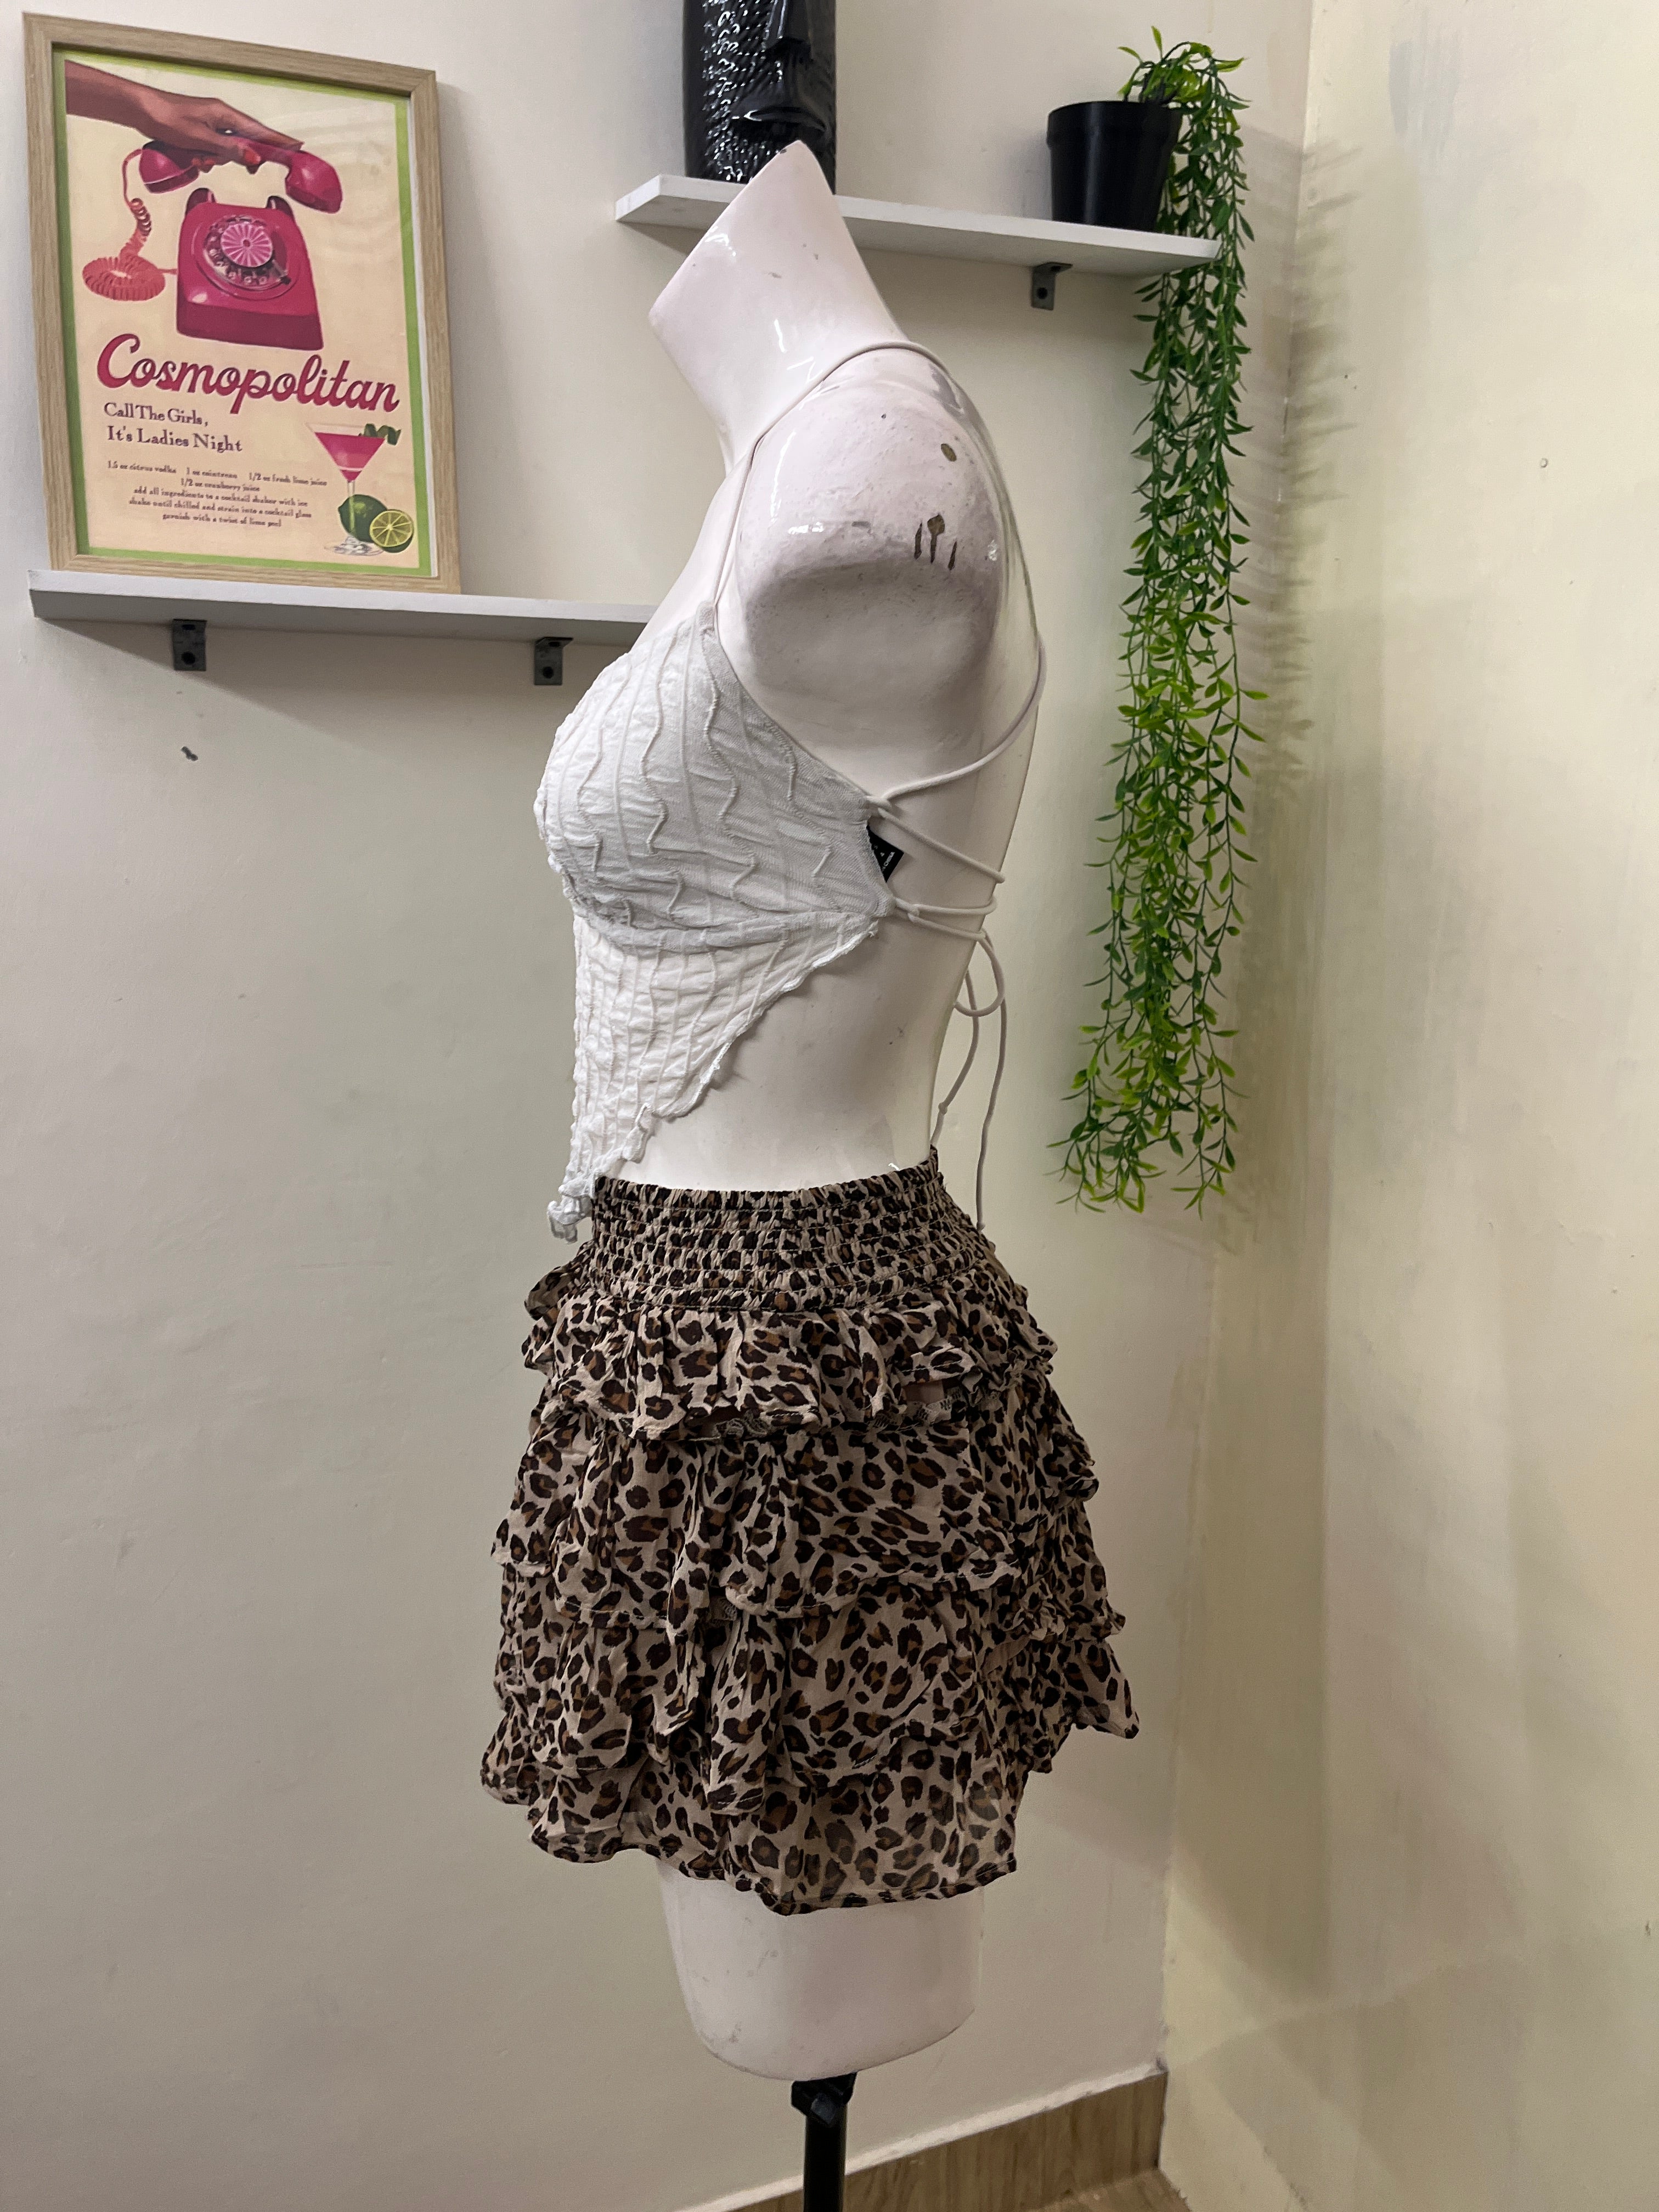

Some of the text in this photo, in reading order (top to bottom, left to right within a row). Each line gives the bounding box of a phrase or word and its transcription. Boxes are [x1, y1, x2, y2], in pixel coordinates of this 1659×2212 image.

[97, 334, 399, 414] Cosmopolitan
[104, 402, 208, 427] Call The Girls,
[107, 426, 243, 453] It's Ladies Night
[181, 478, 193, 487] 1/2
[249, 472, 261, 481] 1/2
[134, 486, 147, 494] add
